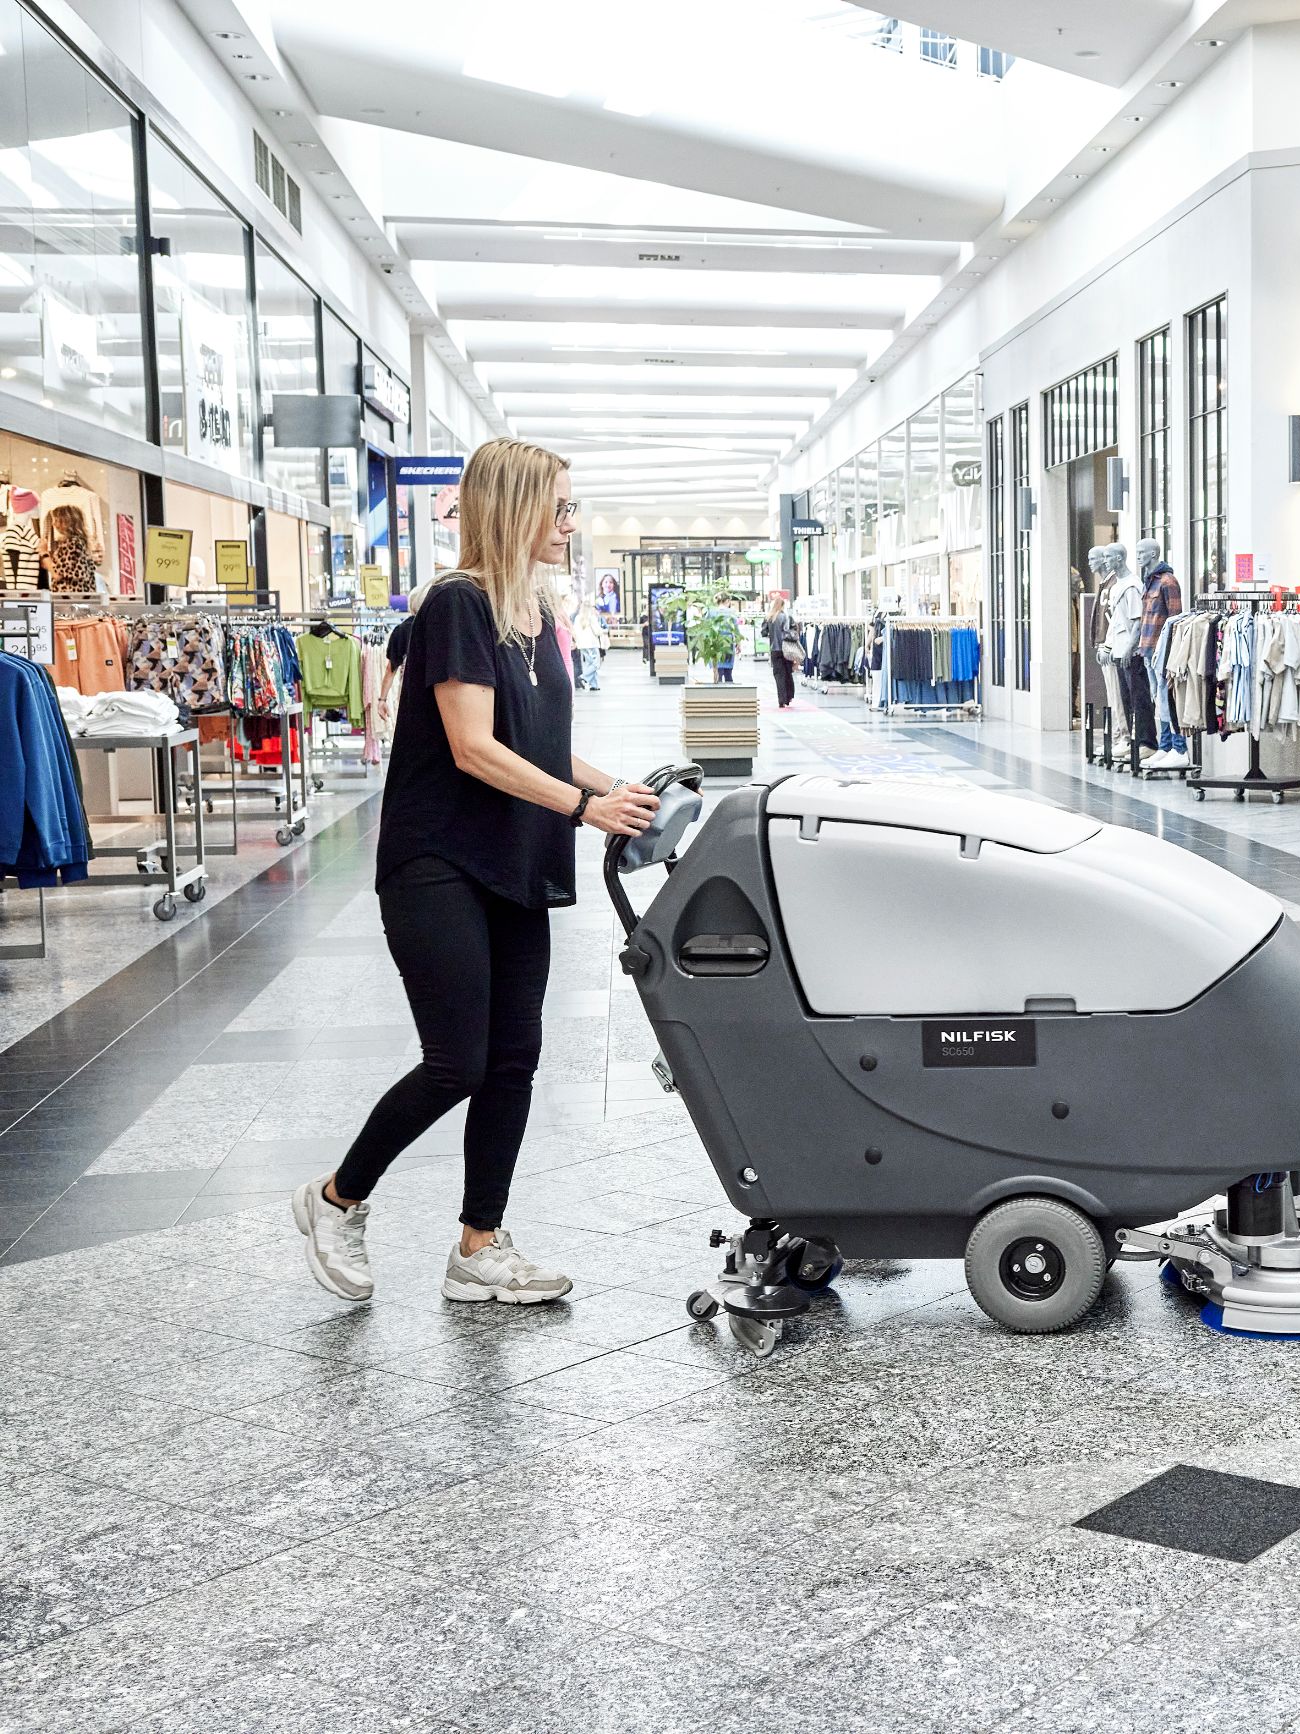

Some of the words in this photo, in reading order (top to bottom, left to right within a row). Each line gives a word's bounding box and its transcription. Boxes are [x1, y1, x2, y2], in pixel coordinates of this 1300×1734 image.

[400, 467, 462, 475] SKECHERS
[793, 527, 823, 535] THIELE
[941, 1030, 1017, 1043] NILFISK
[942, 1046, 975, 1056] SC650
